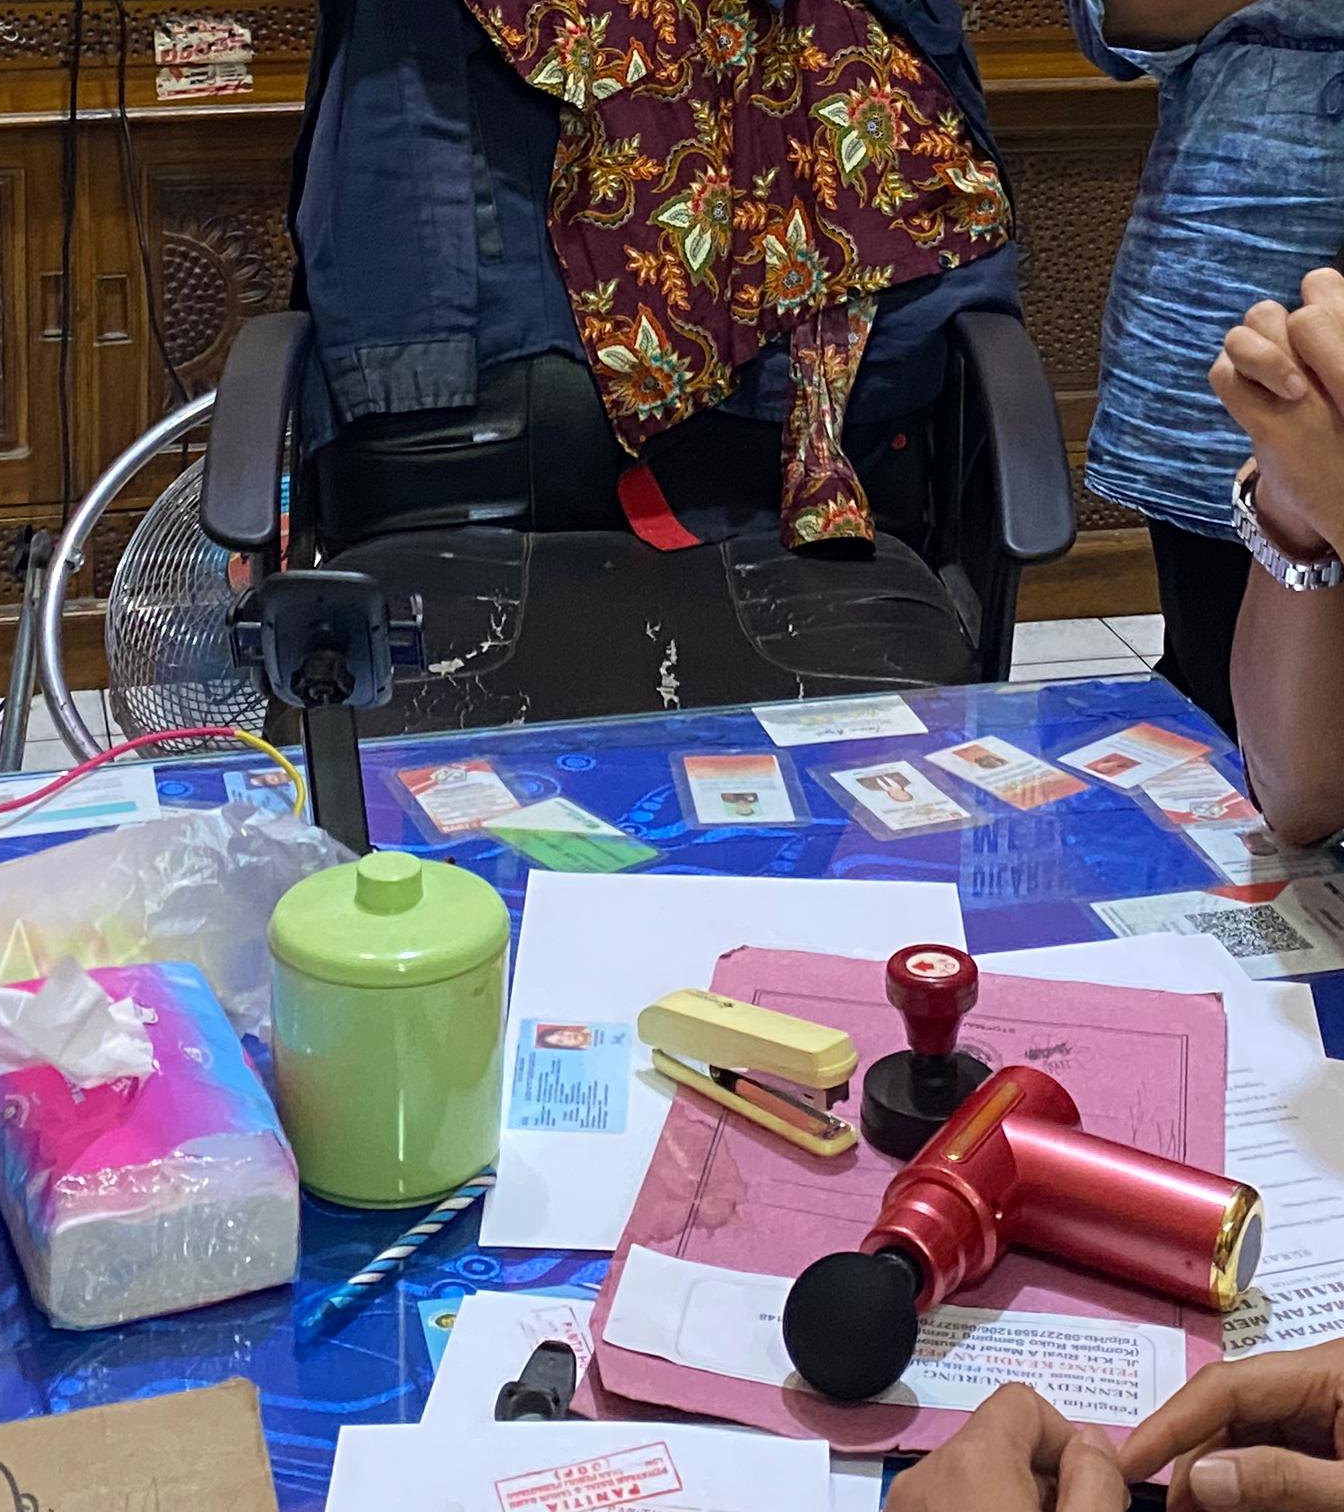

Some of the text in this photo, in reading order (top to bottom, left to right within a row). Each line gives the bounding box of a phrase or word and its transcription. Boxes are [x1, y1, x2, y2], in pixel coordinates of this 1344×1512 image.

[1028, 1338, 1067, 1350] Ruko
[1222, 1331, 1275, 1352] KOT
[1047, 1382, 1139, 1400] KENNEDY
[1063, 1399, 1139, 1416] Pengirim
